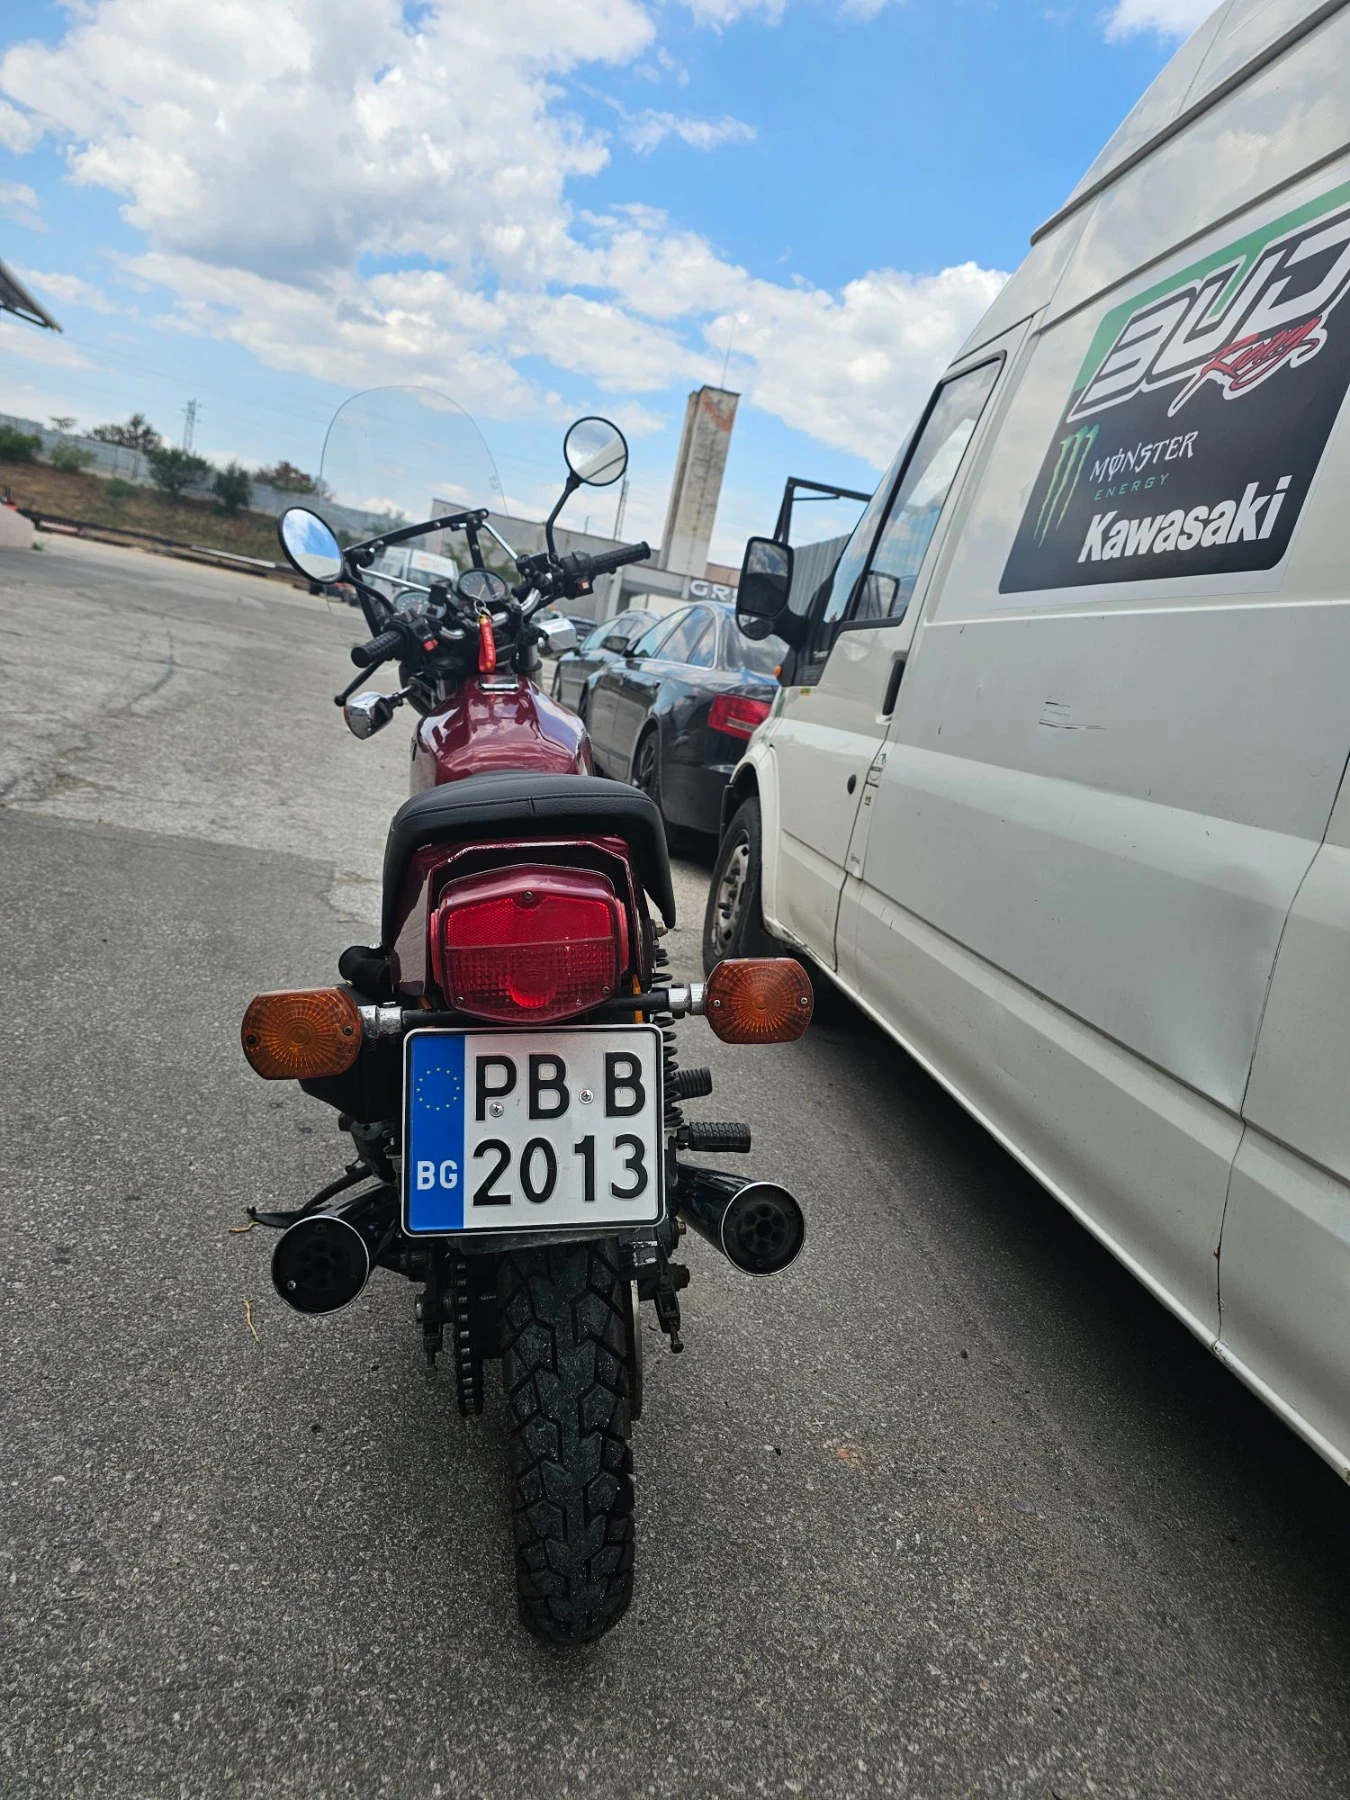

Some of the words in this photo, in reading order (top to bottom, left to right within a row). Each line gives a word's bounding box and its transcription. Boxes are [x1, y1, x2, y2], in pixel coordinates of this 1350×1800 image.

[1094, 473, 1170, 501] ENERGY
[1077, 475, 1293, 563] Kawasaki
[416, 1159, 458, 1190] BG
[472, 1133, 648, 1206] 2013
